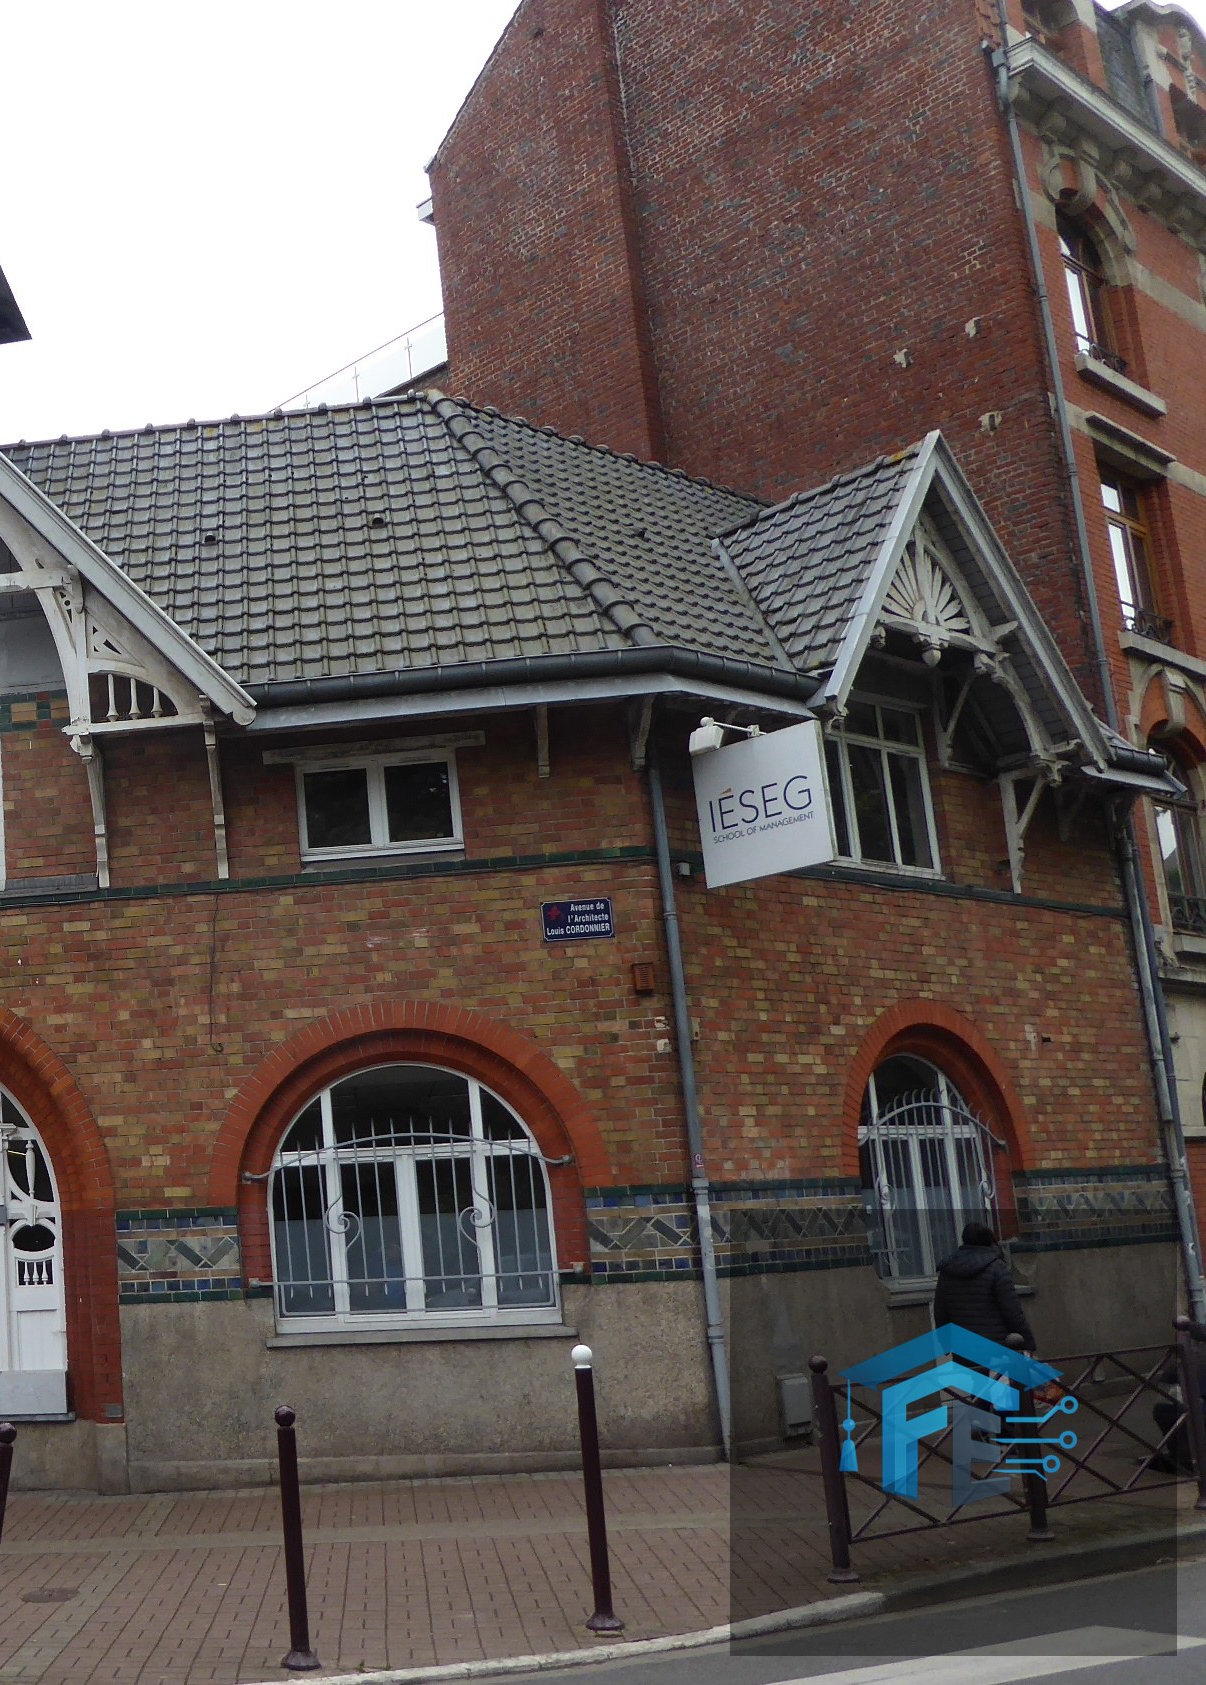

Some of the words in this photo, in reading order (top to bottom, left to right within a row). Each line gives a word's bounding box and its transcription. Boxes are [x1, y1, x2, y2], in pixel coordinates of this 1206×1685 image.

[709, 775, 812, 833] IÉSEG
[713, 829, 745, 844] SCHOOL
[747, 826, 757, 836] OF
[759, 811, 814, 831] MANAGEMENT
[570, 903, 594, 912] Avenue
[547, 927, 564, 935] Louis
[565, 923, 610, 933] CORDONNIER
